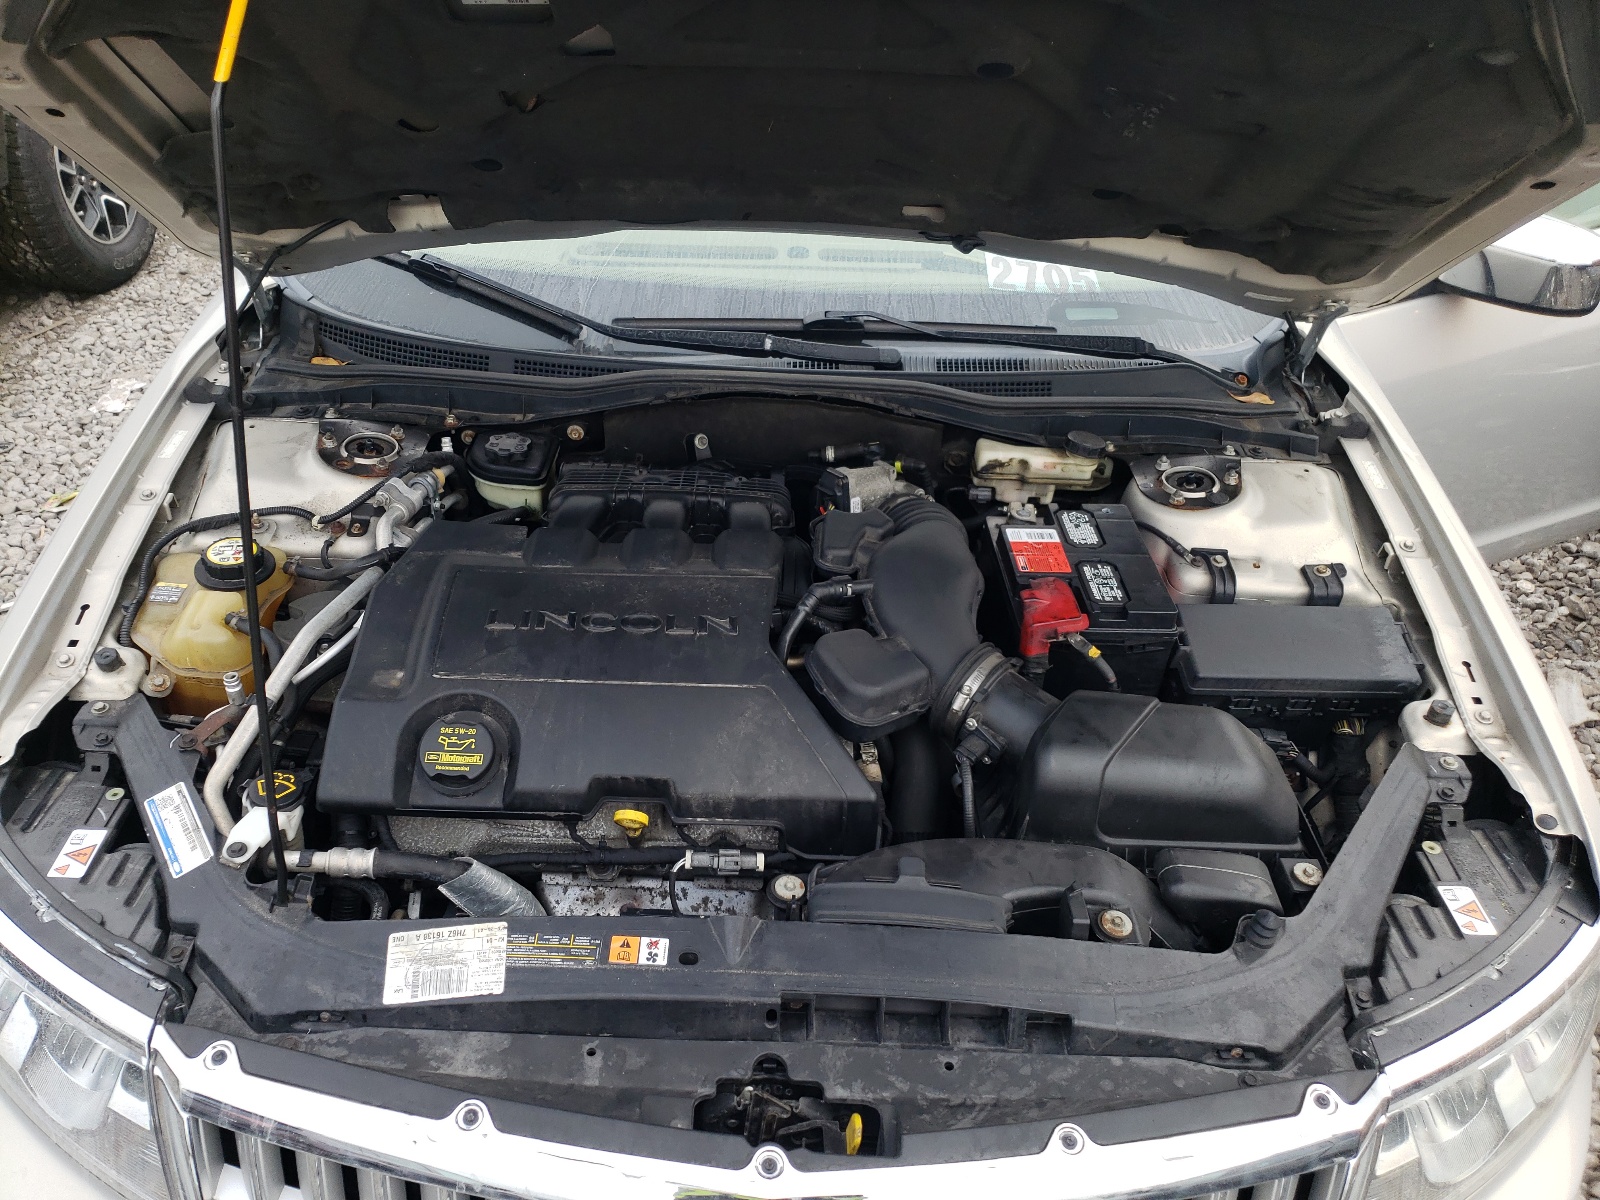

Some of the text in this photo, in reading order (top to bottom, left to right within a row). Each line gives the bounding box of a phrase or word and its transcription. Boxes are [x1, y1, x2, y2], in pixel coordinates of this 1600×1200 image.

[992, 256, 1097, 293] 2705
[484, 609, 739, 636] LINCOLN
[441, 753, 480, 763] Motorcraft
